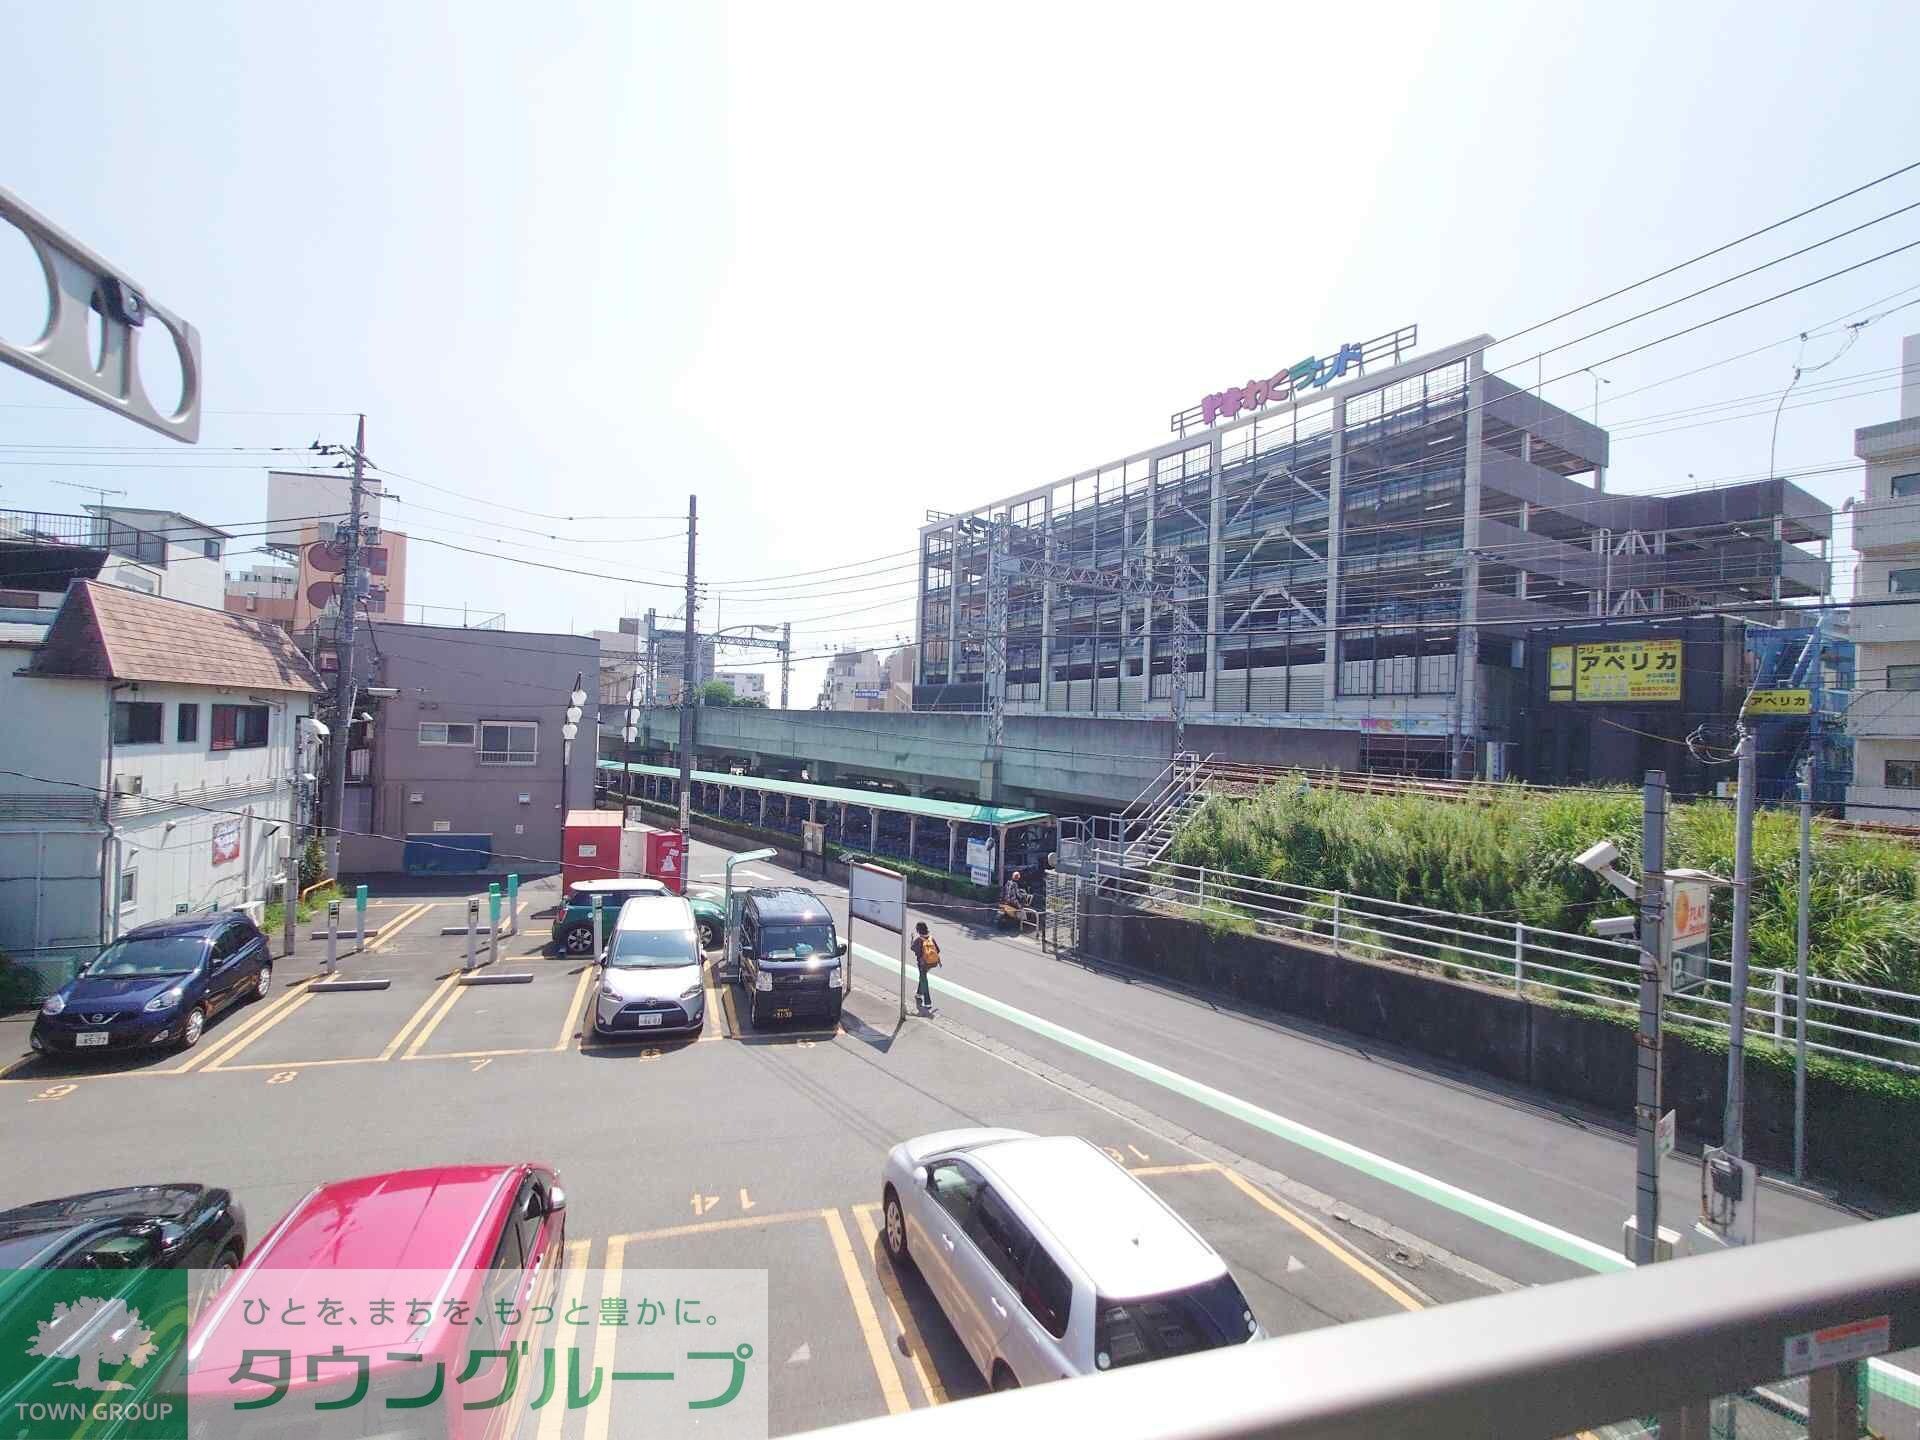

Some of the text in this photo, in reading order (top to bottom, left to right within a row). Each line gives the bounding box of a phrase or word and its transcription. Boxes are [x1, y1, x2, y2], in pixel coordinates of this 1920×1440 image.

[1580, 652, 1677, 672] アペリカ
[1750, 696, 1805, 706] アペリカ
